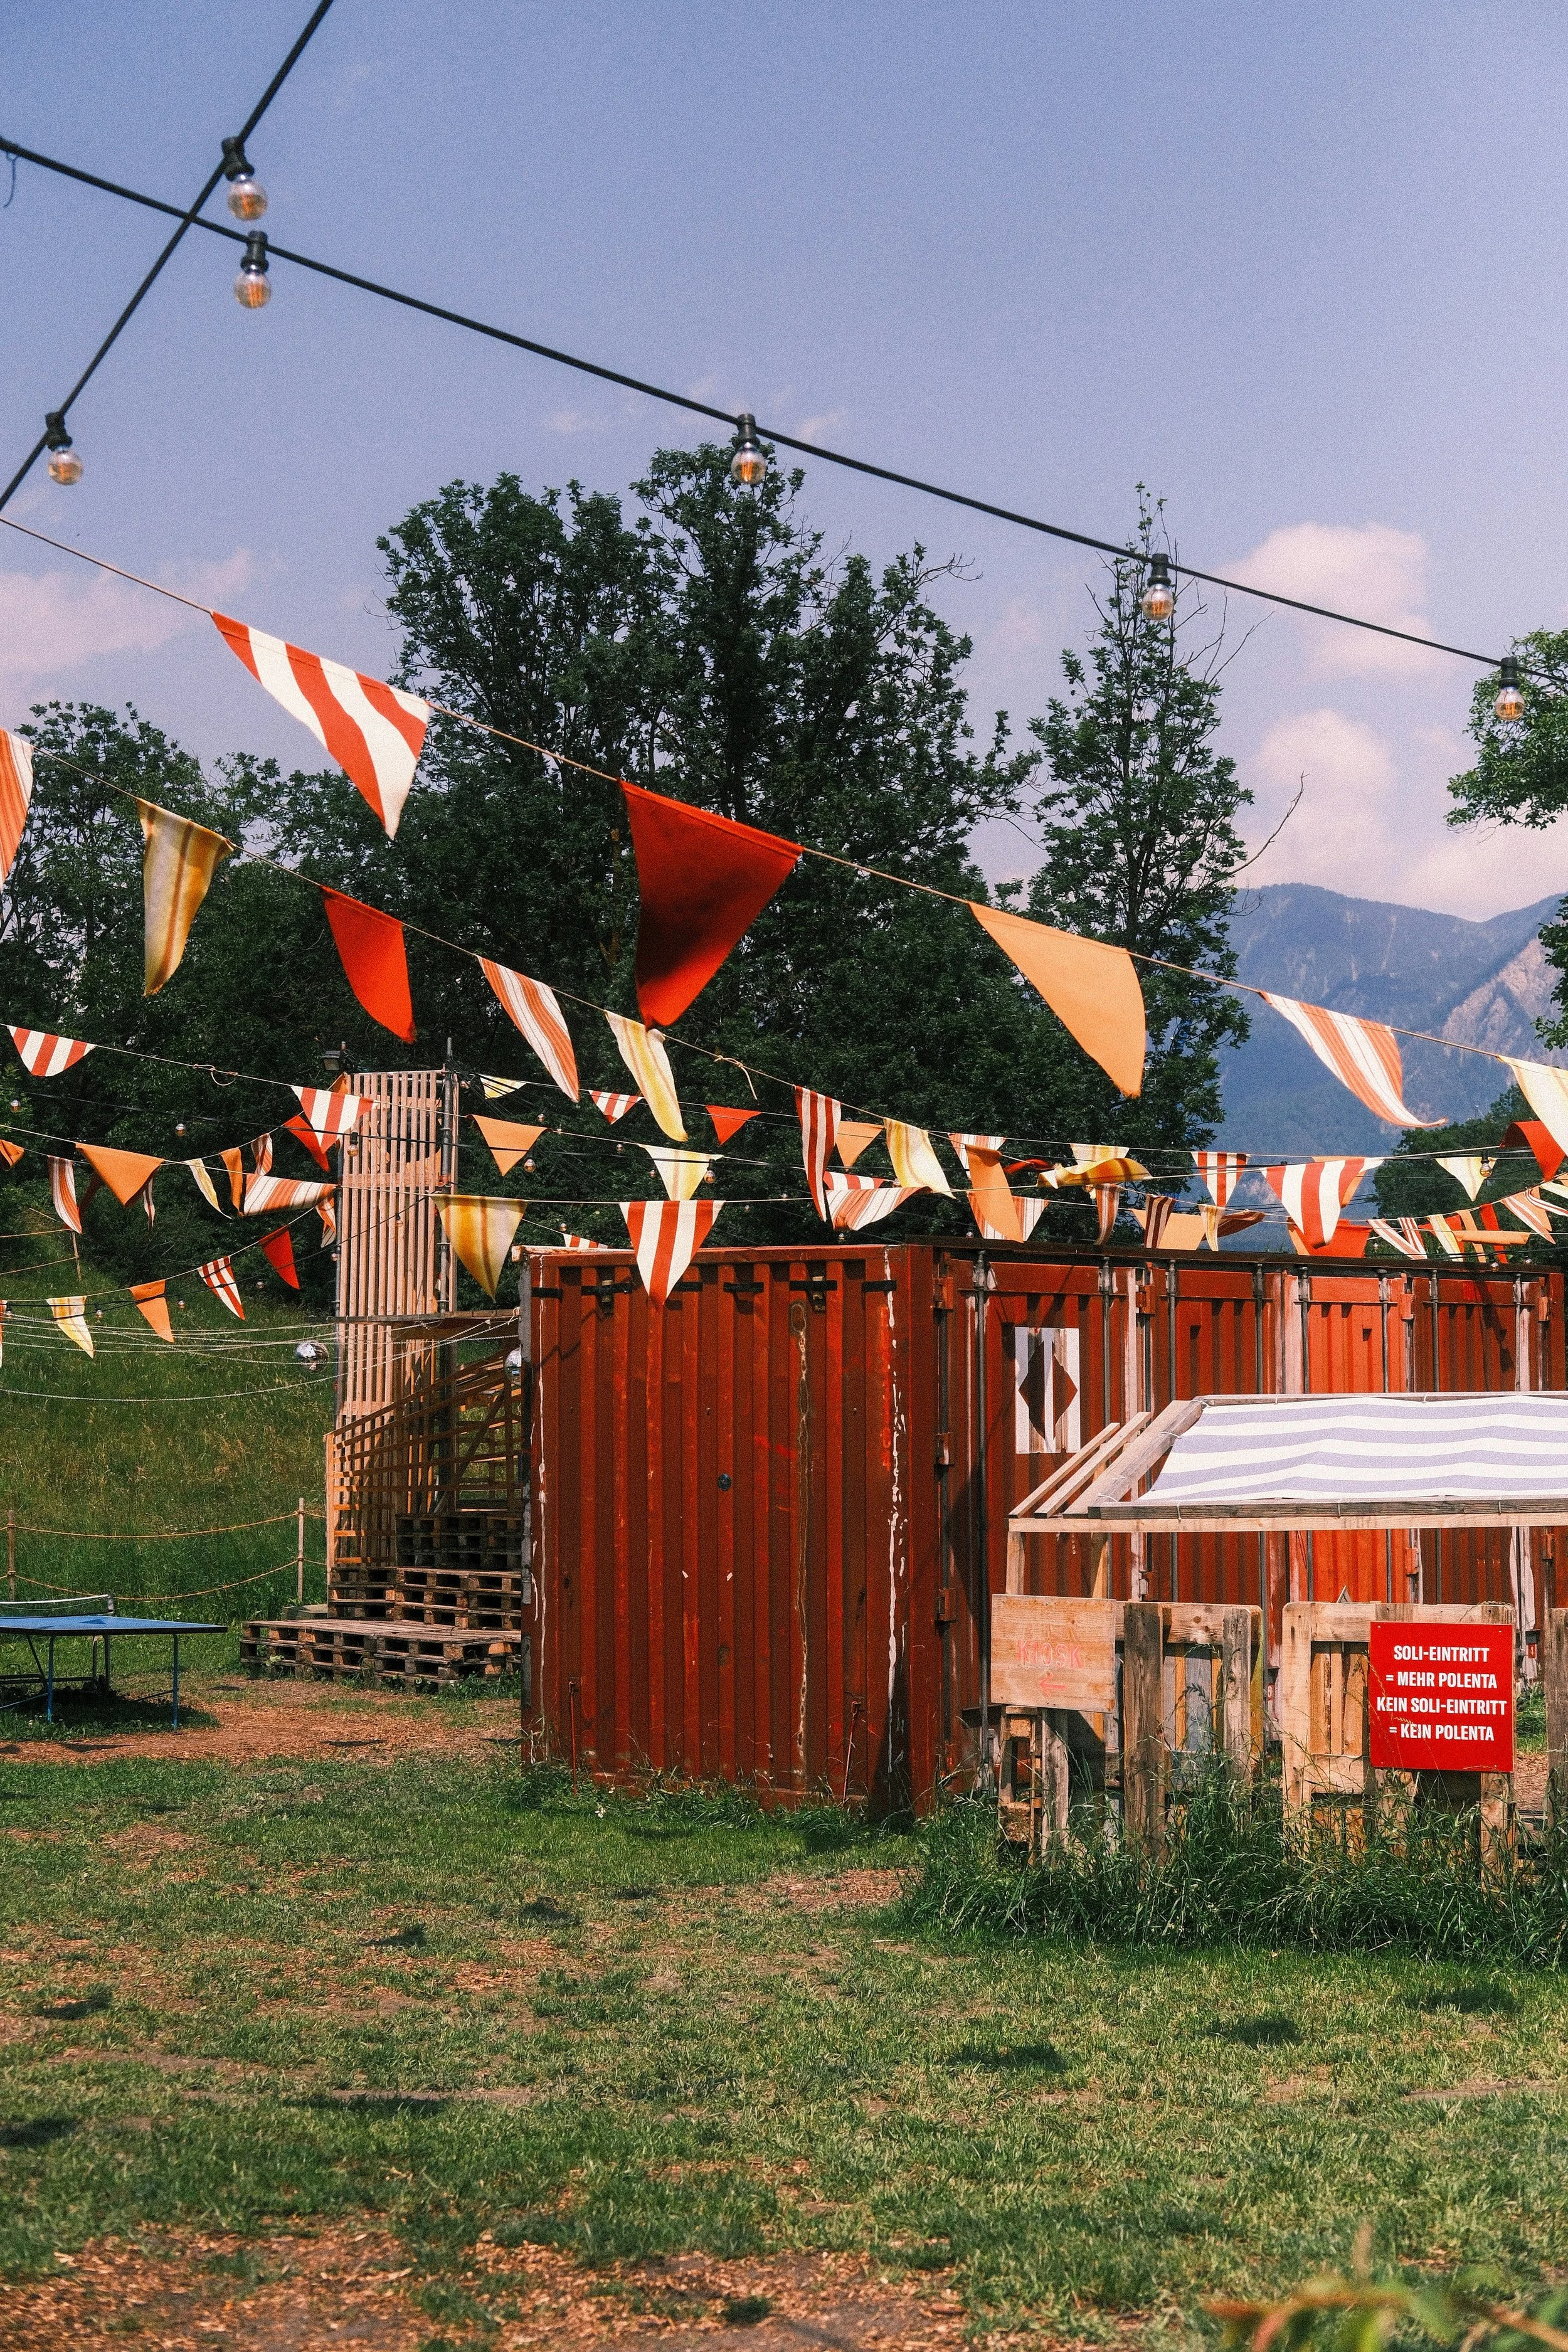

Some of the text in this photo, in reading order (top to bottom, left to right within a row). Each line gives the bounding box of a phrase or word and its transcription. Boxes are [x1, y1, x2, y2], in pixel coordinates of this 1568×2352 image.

[1017, 1639, 1083, 1669] KIOSK
[1394, 1645, 1490, 1662] SOLI-EINTRITT
[1397, 1671, 1435, 1687] MEHR
[1438, 1673, 1498, 1689] POLENTA
[1377, 1697, 1507, 1715] KEIN SOLI-EINTRITT
[1401, 1724, 1431, 1739] KEIN
[1435, 1724, 1495, 1741] POLENTA
